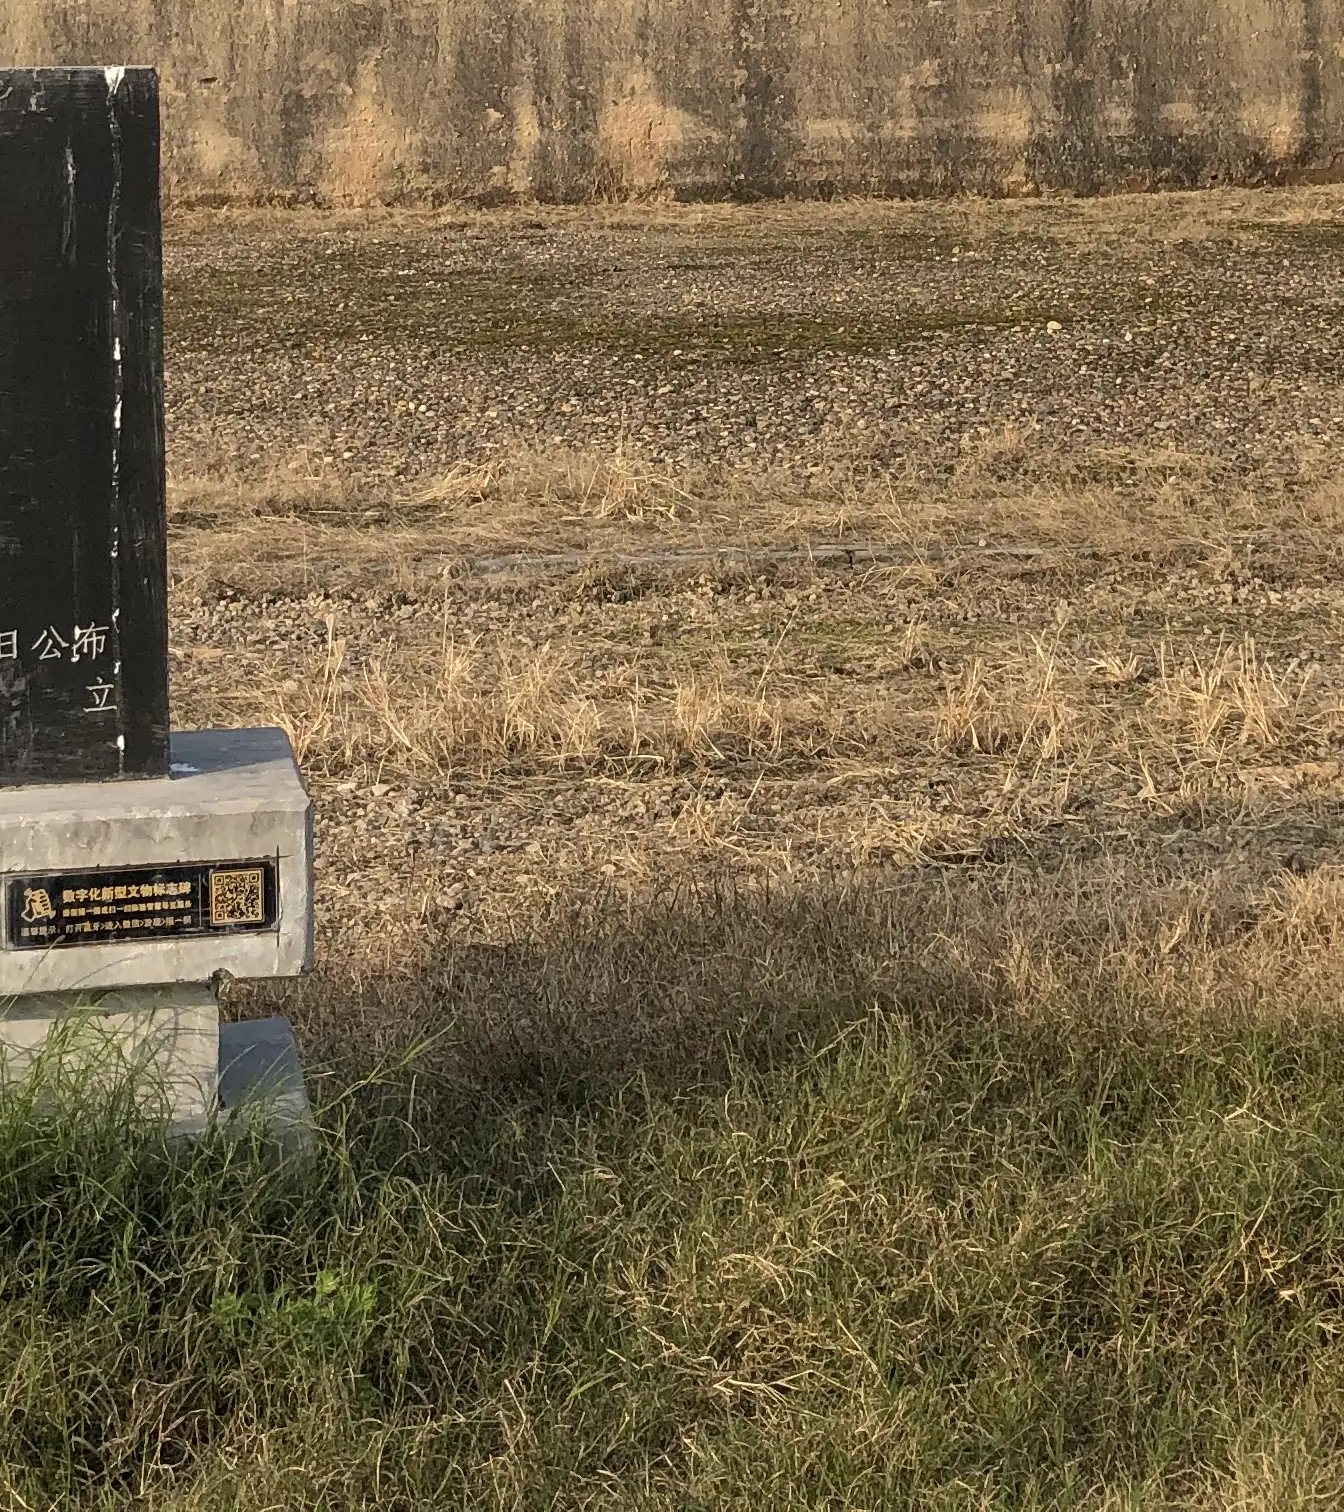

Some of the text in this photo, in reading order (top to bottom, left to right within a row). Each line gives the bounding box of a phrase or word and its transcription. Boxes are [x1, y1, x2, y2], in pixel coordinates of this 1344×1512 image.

[82, 676, 118, 713] 立
[62, 881, 193, 904] 数字化新型文物标志碑
